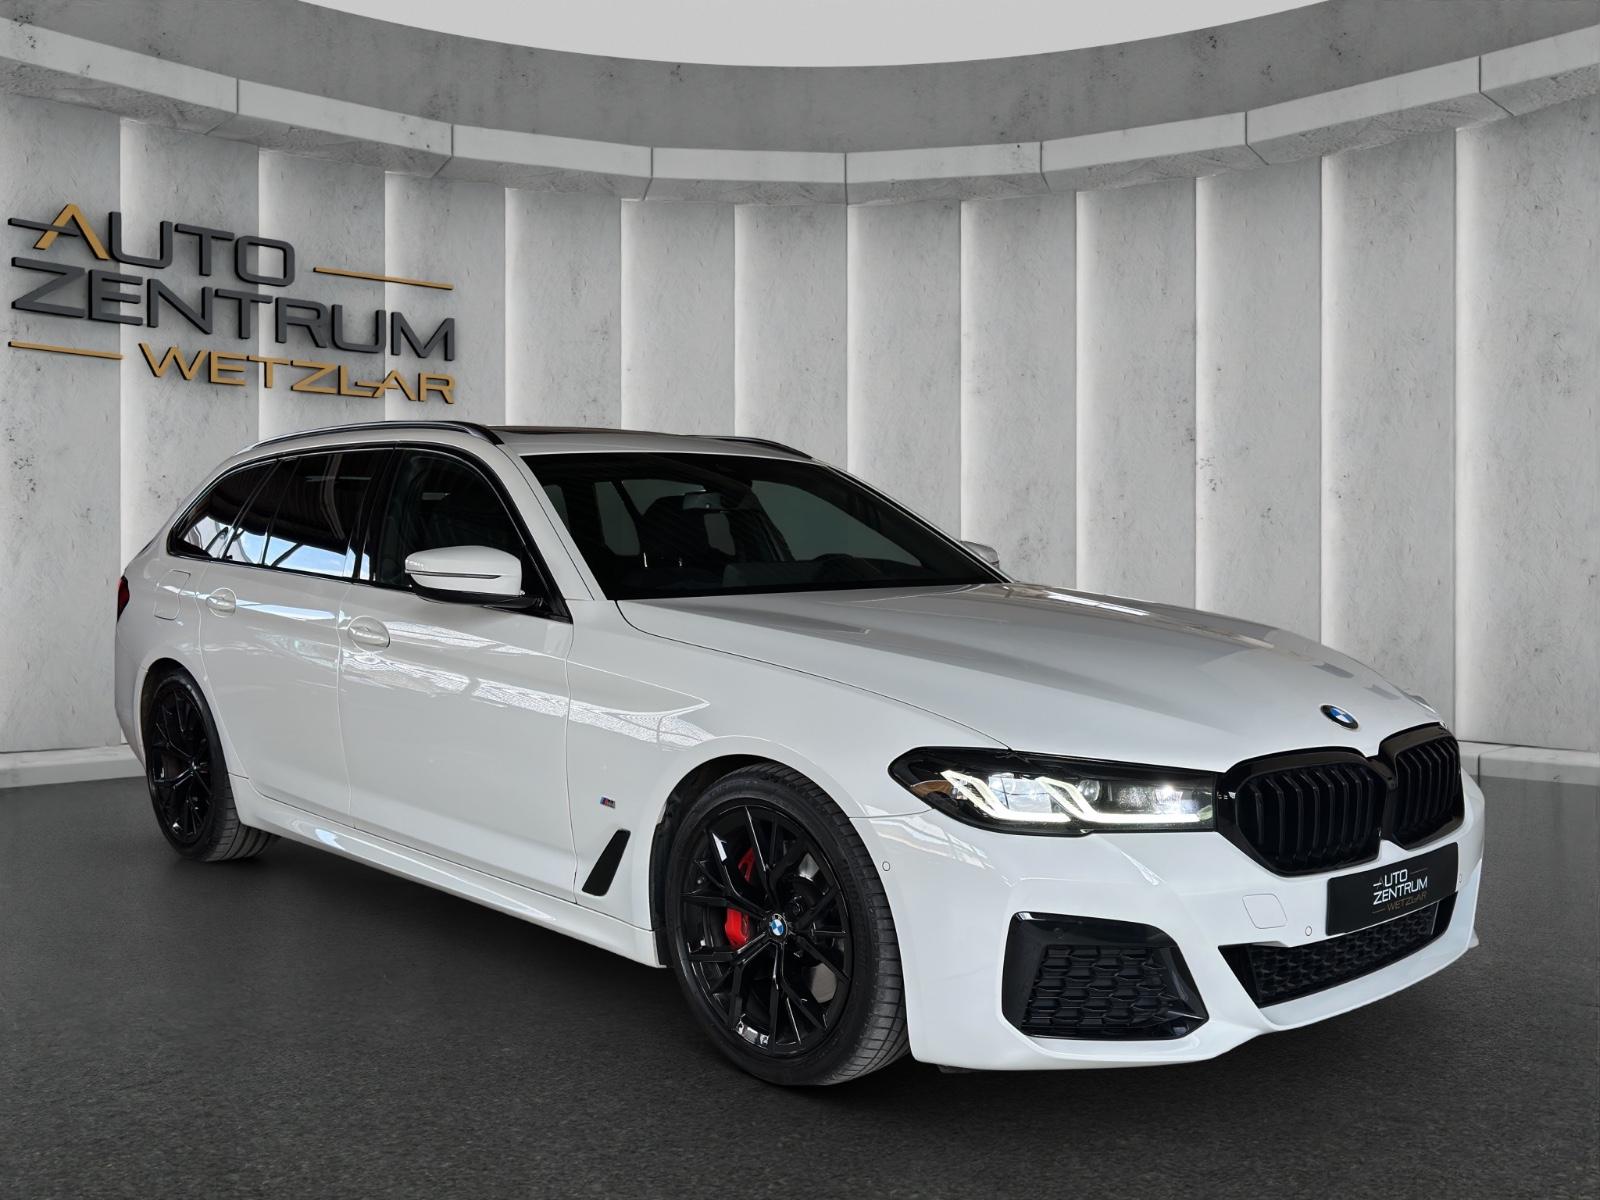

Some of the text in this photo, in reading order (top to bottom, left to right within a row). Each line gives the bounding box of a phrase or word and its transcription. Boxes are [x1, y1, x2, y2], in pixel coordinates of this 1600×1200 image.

[8, 203, 296, 287] AUTO
[11, 256, 456, 361] ZENTRUM
[138, 342, 456, 404] WETZLAR
[1373, 876, 1428, 905] ZENTRUM
